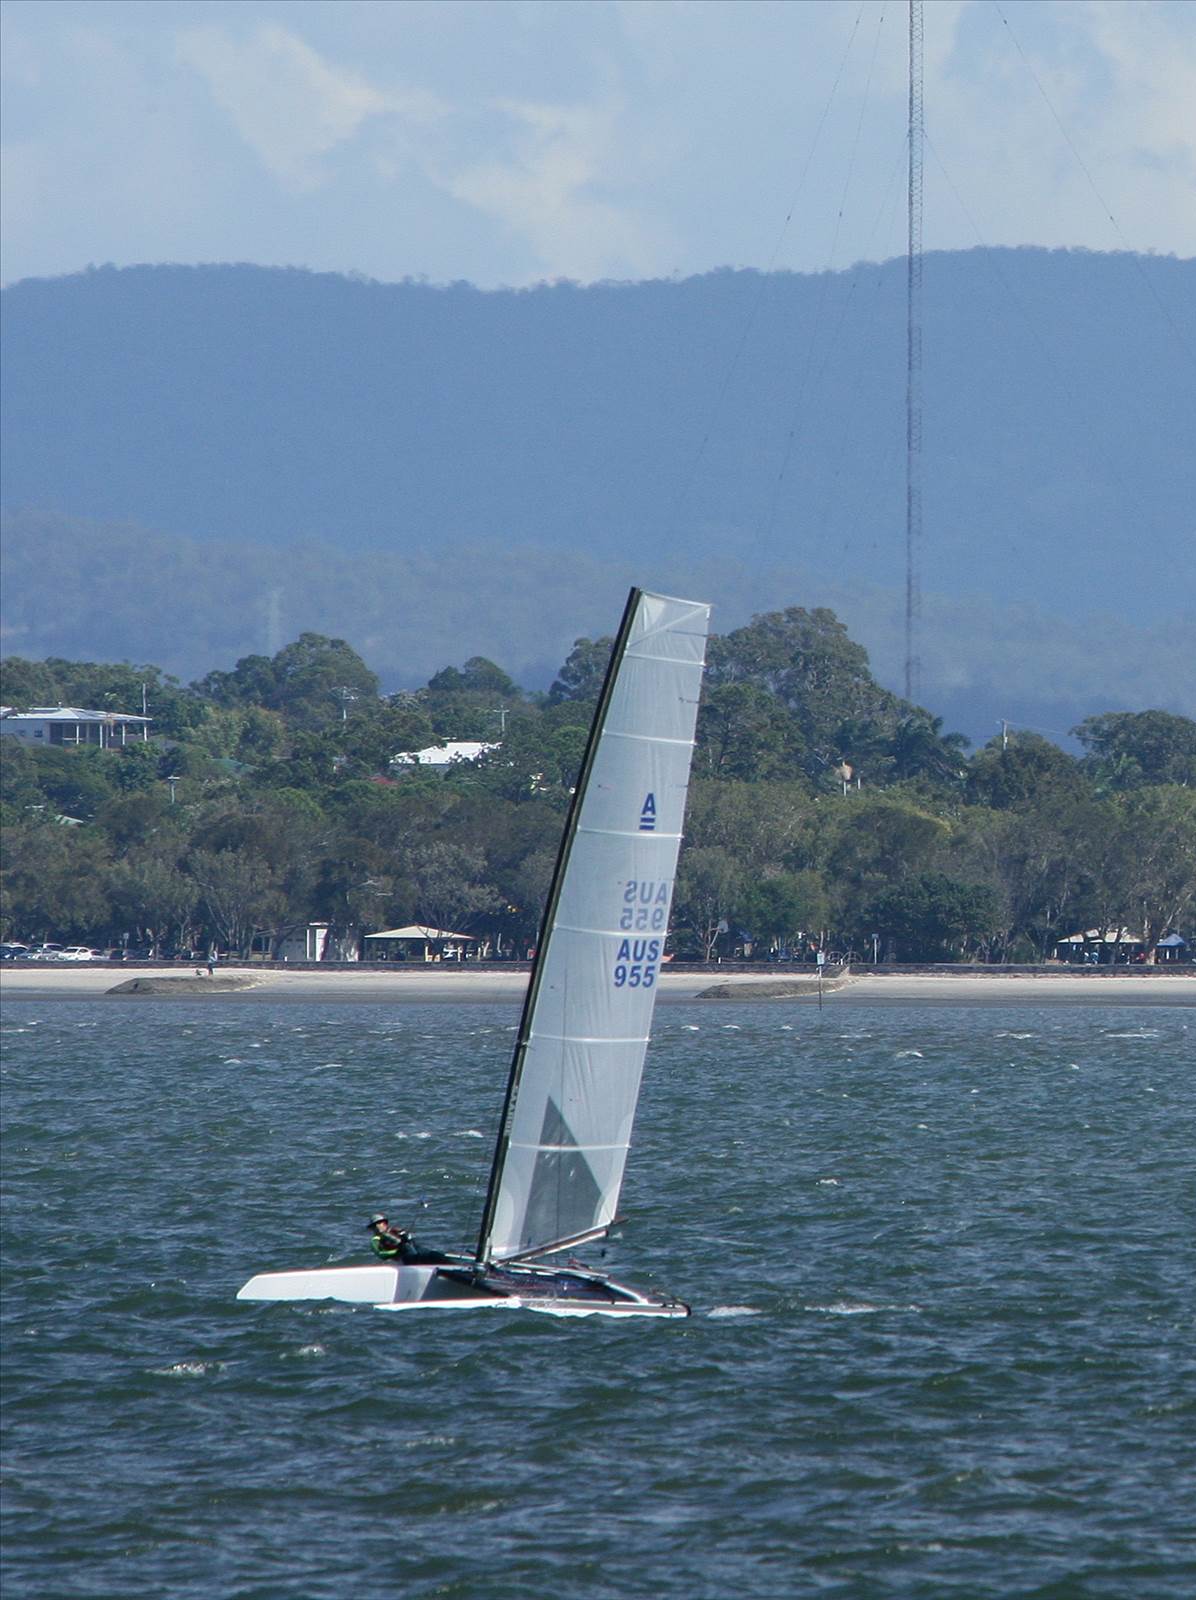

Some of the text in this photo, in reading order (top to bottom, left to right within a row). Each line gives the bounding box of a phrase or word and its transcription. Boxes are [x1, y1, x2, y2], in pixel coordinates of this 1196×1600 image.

[642, 793, 656, 815] A
[617, 939, 660, 962] AUS
[614, 965, 655, 988] 955
